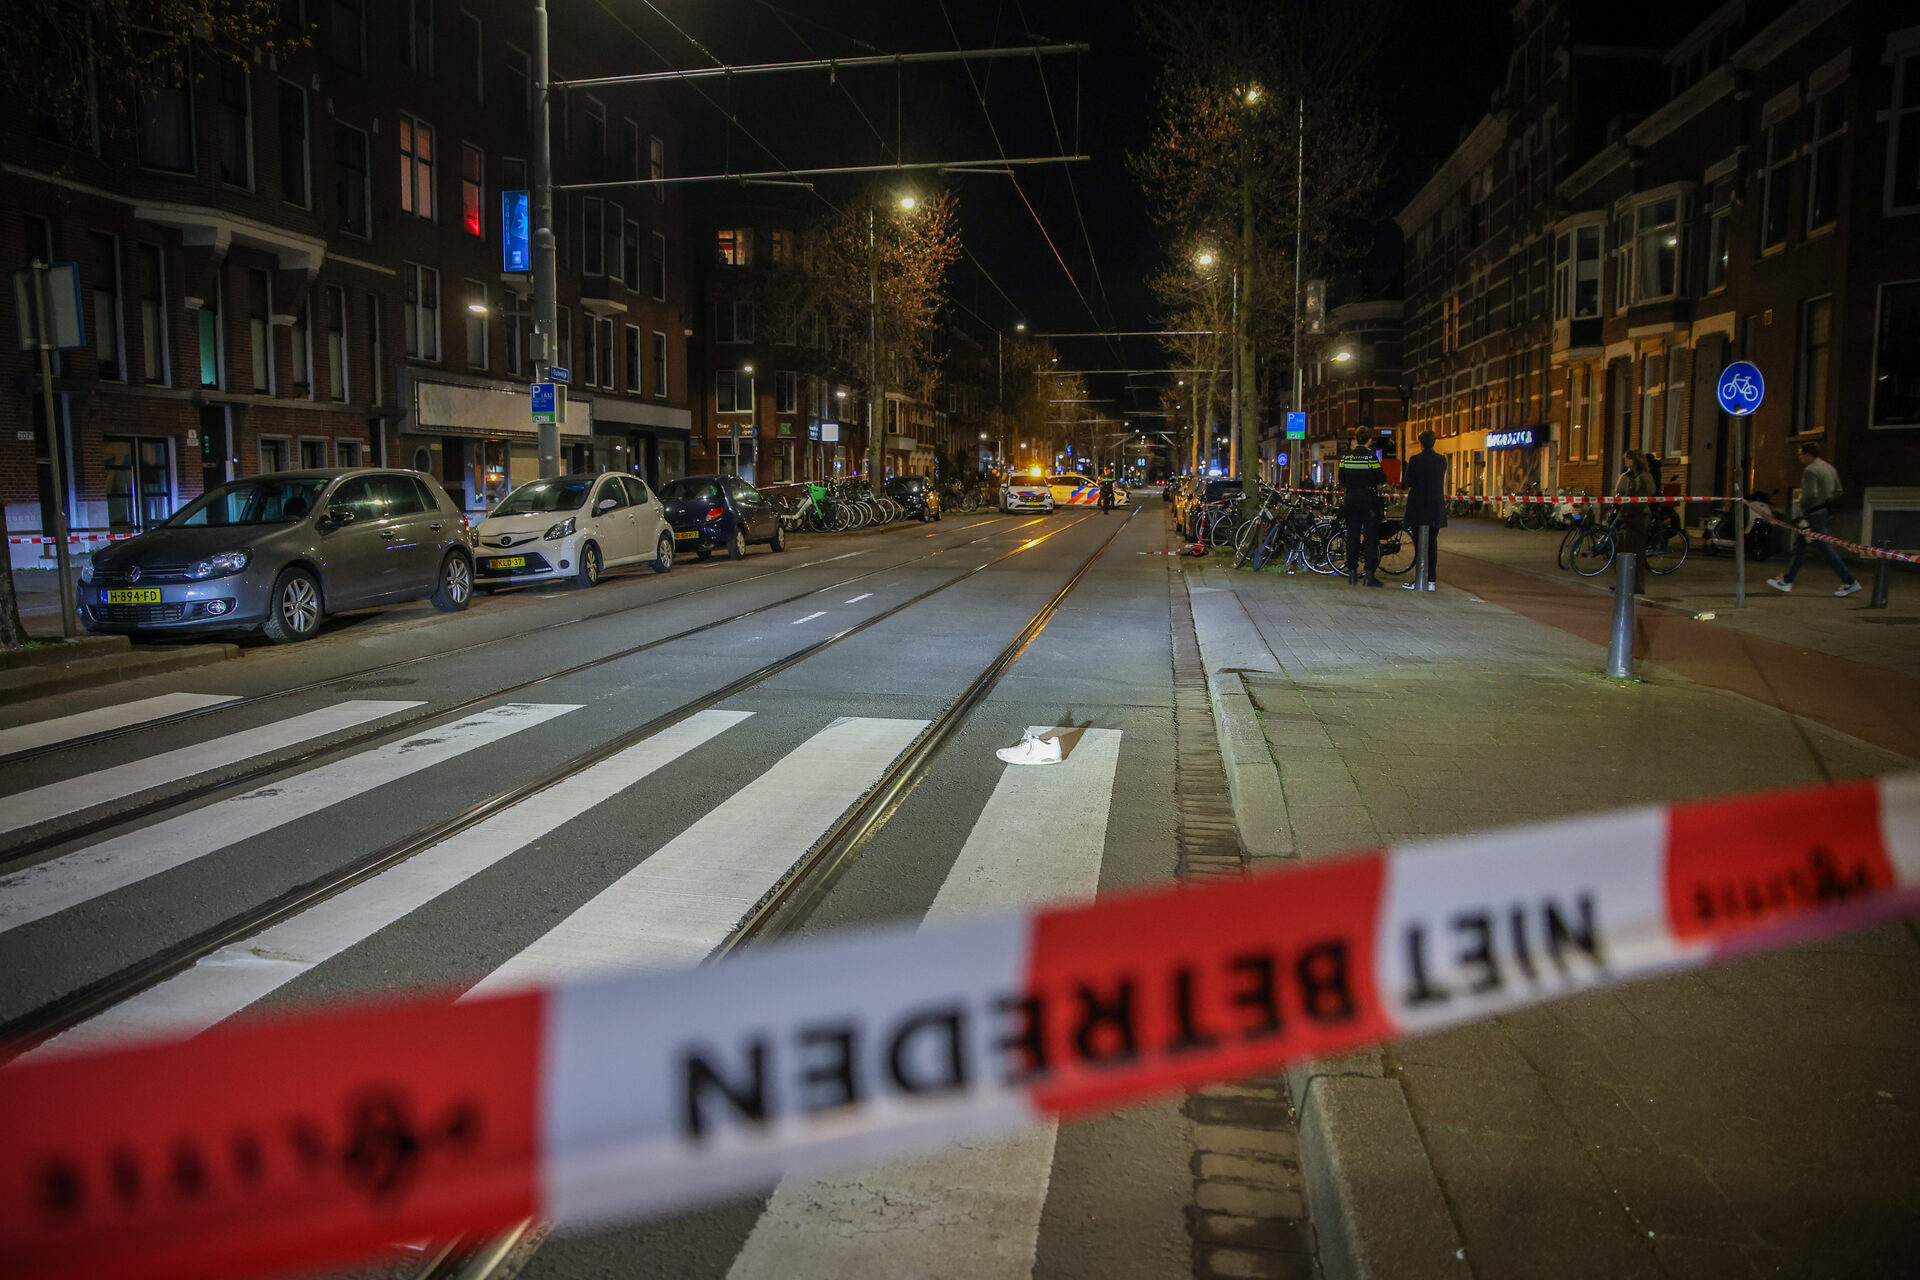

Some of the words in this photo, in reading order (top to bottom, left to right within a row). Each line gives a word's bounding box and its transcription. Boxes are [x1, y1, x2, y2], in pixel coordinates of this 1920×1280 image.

[533, 385, 541, 399] P
[1288, 413, 1295, 422] P
[110, 591, 157, 602] H-894-FD
[1404, 886, 1604, 1007] NIET
[677, 937, 1360, 1138] BETREDEN
